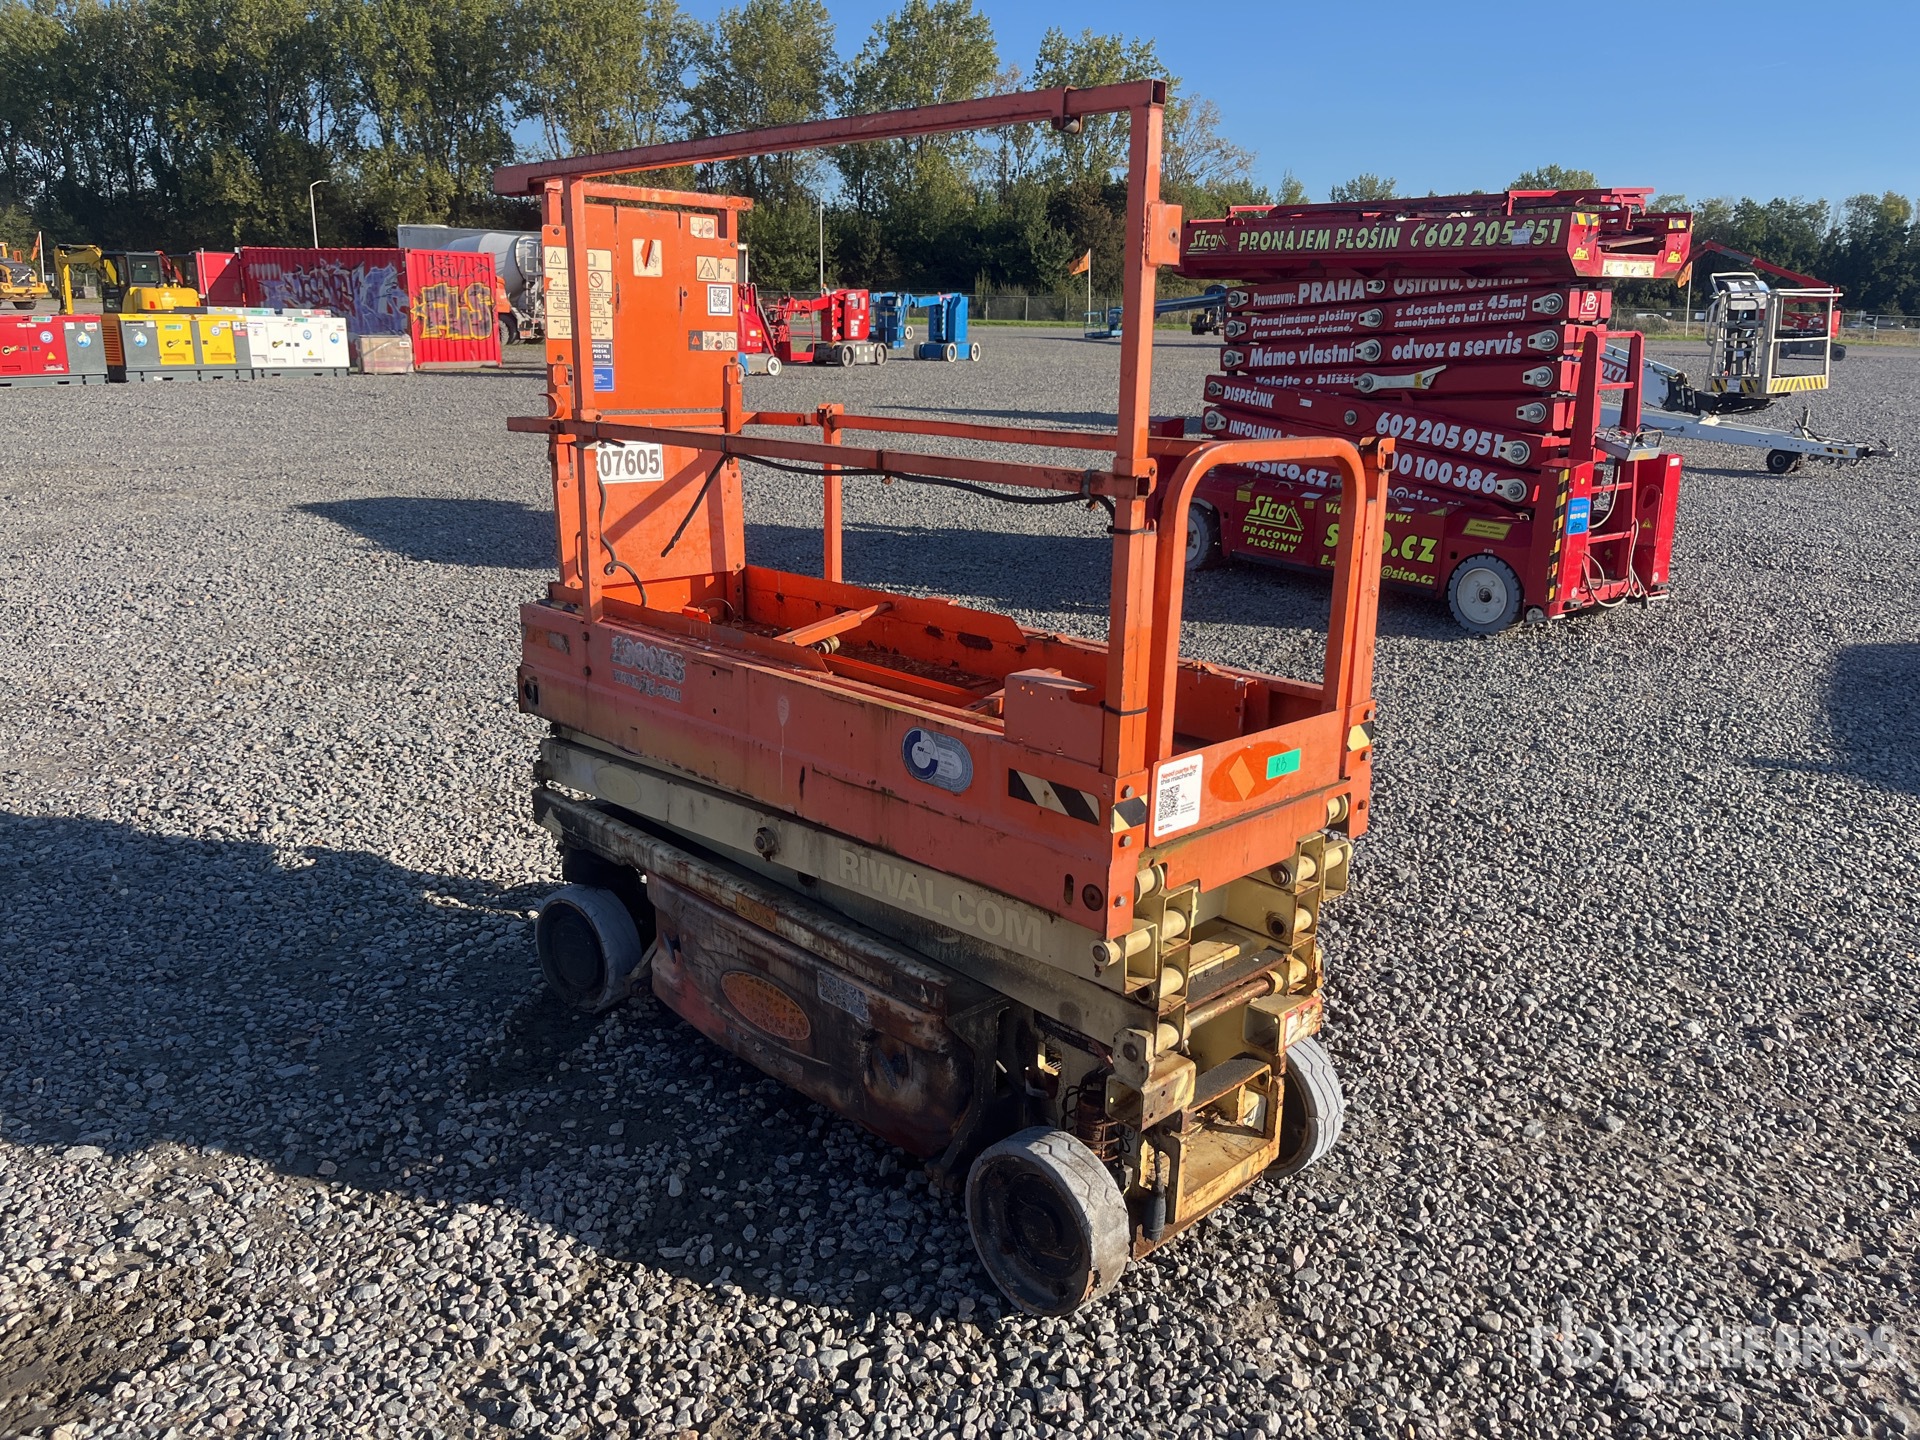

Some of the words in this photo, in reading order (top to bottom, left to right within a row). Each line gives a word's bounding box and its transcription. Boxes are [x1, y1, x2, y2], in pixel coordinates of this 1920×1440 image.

[1238, 225, 1331, 252] PRONÁJEM
[1335, 222, 1401, 250] PLOŠIN
[1424, 221, 1468, 248] 602
[1470, 220, 1516, 247] 205
[1253, 292, 1296, 306] Provozovny:
[1298, 278, 1366, 305] PRAHA
[1250, 313, 1316, 328] Pronajímáme
[1318, 309, 1358, 325] plošiny
[1395, 308, 1403, 317] s
[1406, 302, 1466, 317] dosahem
[1469, 300, 1484, 311] až
[1487, 294, 1528, 310] 45m!
[1252, 329, 1268, 340] (na
[1270, 327, 1304, 338] autech,
[1307, 324, 1354, 337] přívěsné,
[1394, 316, 1447, 328] samohybné
[1449, 313, 1461, 324] do
[1463, 312, 1479, 323] hal
[1481, 311, 1486, 321] i
[1488, 309, 1526, 322] terénu)
[1249, 346, 1297, 368] Máme
[1299, 342, 1355, 365] vlastní
[1391, 337, 1446, 360] odvoz
[1448, 341, 1461, 357] a
[1463, 331, 1523, 357] servis
[1255, 375, 1301, 388] Volejte
[1304, 377, 1314, 385] o
[1223, 385, 1275, 409] DISPEČINK
[1228, 420, 1283, 440] INFOLINKA
[1375, 411, 1417, 441] 602
[1416, 419, 1461, 450] 205
[596, 448, 660, 477] 07605
[1415, 455, 1453, 485] 100
[1452, 464, 1499, 495] 386
[1242, 524, 1304, 544] PRACOVNÍ
[1246, 536, 1297, 554] PLOŠINY
[1161, 770, 1175, 779] Need
[1175, 766, 1190, 776] parts
[1171, 770, 1196, 782] machine?
[838, 848, 1043, 954] RIWAL.COM
